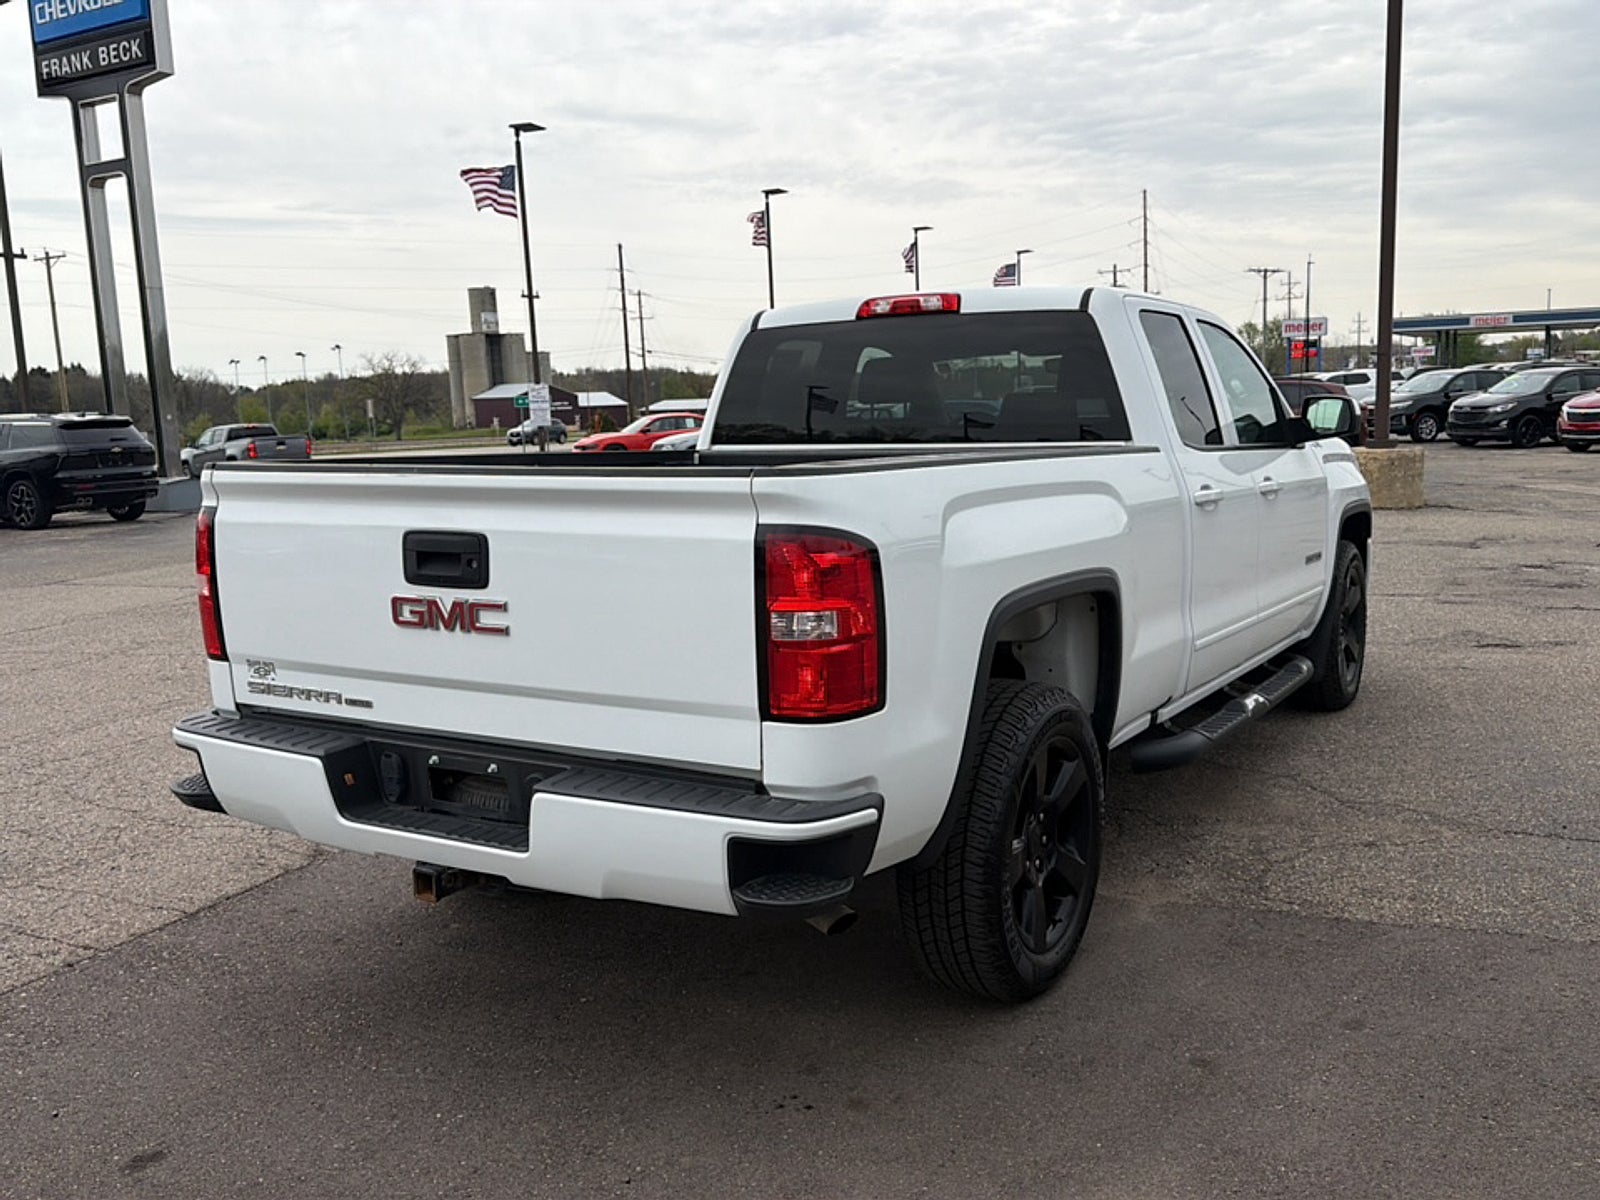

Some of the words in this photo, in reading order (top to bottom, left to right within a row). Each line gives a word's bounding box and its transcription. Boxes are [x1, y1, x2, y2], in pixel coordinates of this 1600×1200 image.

[41, 50, 93, 80] FRANK
[98, 38, 143, 67] BECK
[391, 594, 511, 637] GMC
[247, 680, 343, 705] SIERRA
